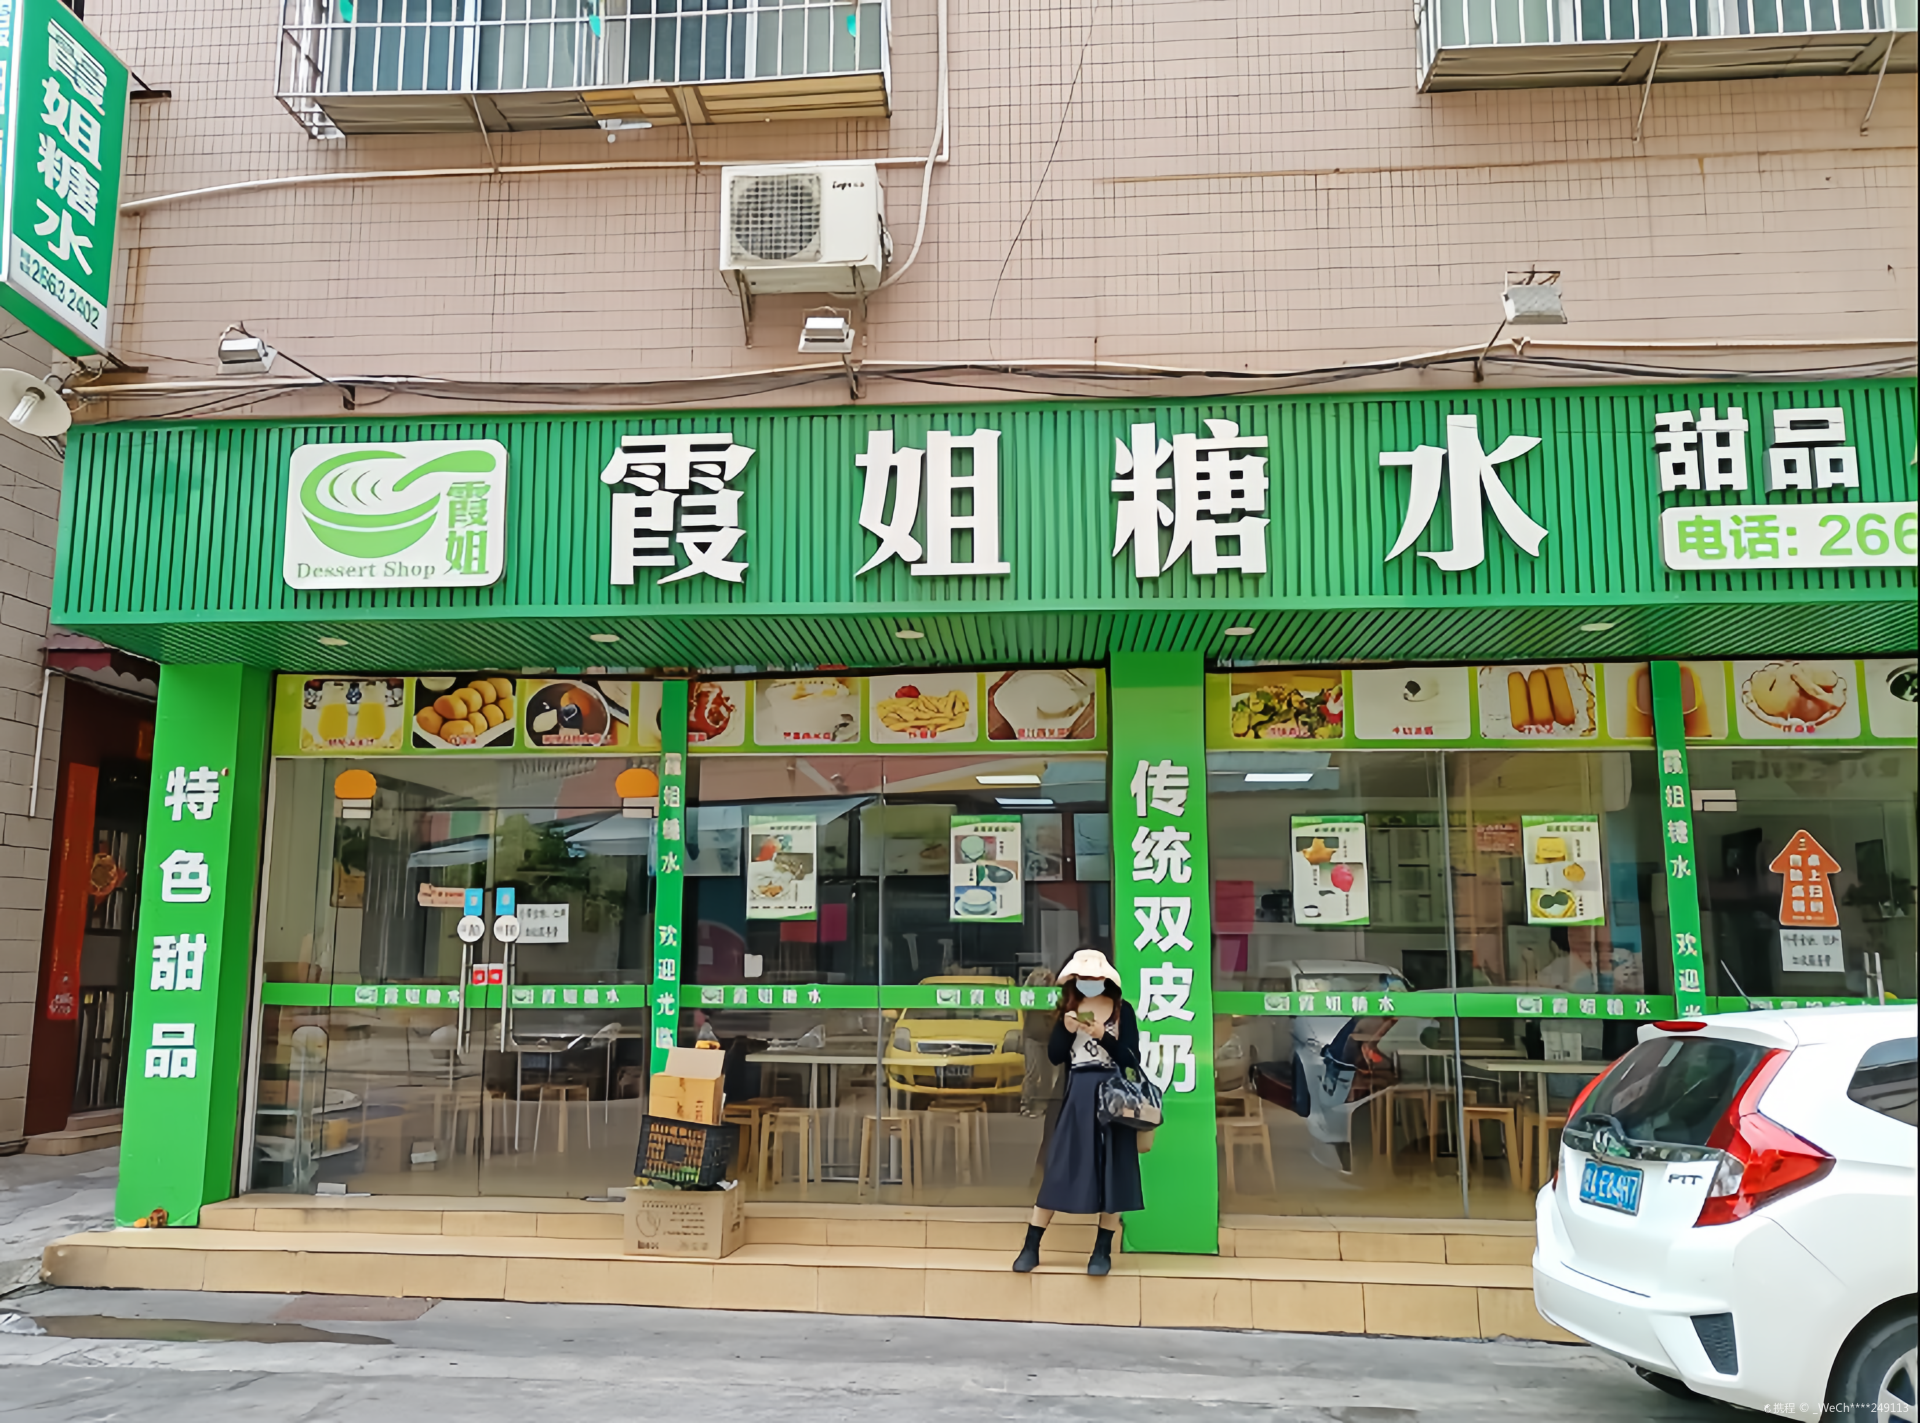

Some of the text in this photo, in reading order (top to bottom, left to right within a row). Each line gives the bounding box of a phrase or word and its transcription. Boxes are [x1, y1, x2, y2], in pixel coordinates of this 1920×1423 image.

[35, 18, 107, 276] 霞姐糖水
[443, 481, 491, 575] 霞姐
[600, 414, 1549, 586] 霞姐糖水
[1655, 407, 1859, 491] 甜品
[297, 561, 435, 579] Dessert Shop
[145, 766, 219, 1078] 特色甜品
[1130, 760, 1196, 1093] 传统双皮奶
